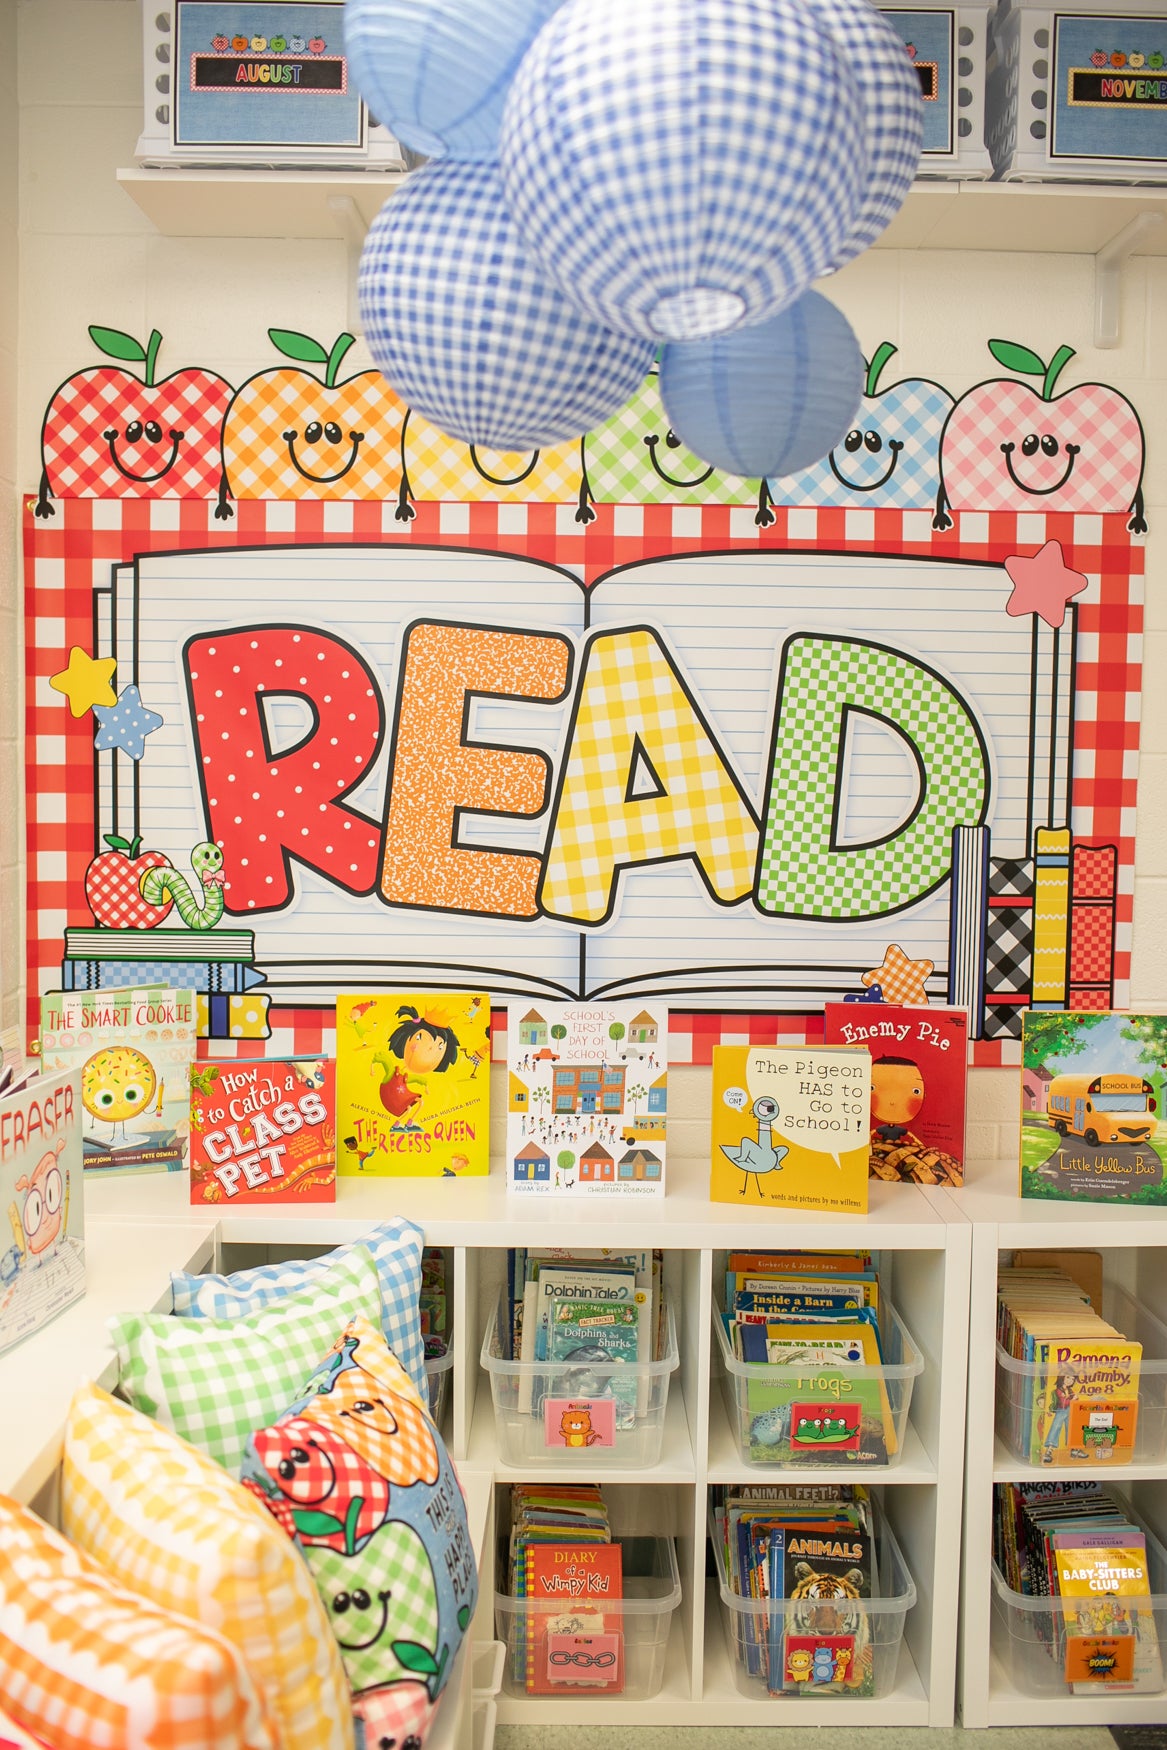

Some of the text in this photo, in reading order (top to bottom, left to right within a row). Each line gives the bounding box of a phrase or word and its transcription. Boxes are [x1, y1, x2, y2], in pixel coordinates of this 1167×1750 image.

[236, 64, 302, 84] AUGUST
[183, 618, 992, 927] READ
[48, 1004, 192, 1031] THE SMART COOKIE
[563, 1011, 616, 1021] SCHOOL'S
[569, 1035, 606, 1046] DAY OF
[840, 1021, 950, 1050] Enemy Pie
[566, 1049, 611, 1060] SCHOOL
[755, 1060, 863, 1079] The Pigeon
[220, 1068, 258, 1096] How
[799, 1082, 863, 1098] HAS to
[207, 1075, 295, 1124] to Catch a
[350, 1103, 369, 1113] ALEXIS
[809, 1100, 863, 1114] Go to
[420, 1113, 439, 1123] LAURA
[202, 1092, 328, 1164] CLASS
[353, 1118, 378, 1143] THE
[433, 1120, 477, 1142] QUEEN
[379, 1133, 432, 1154] RECESS
[84, 1157, 97, 1165] JORY
[97, 1156, 112, 1164] JOHN
[156, 1150, 178, 1158] OSWALD
[1060, 1153, 1156, 1175] Little Yellow Bus
[213, 1144, 286, 1197] PET
[799, 1196, 821, 1204] pictures
[822, 1197, 829, 1206] by
[757, 1261, 789, 1269] Kimberly
[545, 1283, 629, 1300] Dolphin Tale 2
[753, 1294, 833, 1307] Inside a Barn
[753, 1305, 765, 1313] in
[768, 1305, 788, 1313] the
[593, 1316, 613, 1324] TRACKER
[564, 1328, 607, 1339] Dolphins
[598, 1339, 631, 1348] Sharks
[1057, 1347, 1131, 1369] Ramona
[1075, 1370, 1131, 1387] Quimby,
[1079, 1385, 1114, 1396] Age 8
[743, 1486, 839, 1500] ANIMAL FEET!?
[425, 1487, 450, 1533] THIS
[775, 1534, 783, 1544] 2
[787, 1538, 863, 1559] ANIMALS
[554, 1551, 598, 1563] DIARY
[565, 1565, 576, 1576] of
[1094, 1561, 1109, 1569] THE
[1063, 1568, 1143, 1580] BABY-SITTERS
[540, 1573, 610, 1596] Wimpy Kid
[1089, 1580, 1120, 1590] CLUB
[1089, 1659, 1115, 1667] BOOM!
